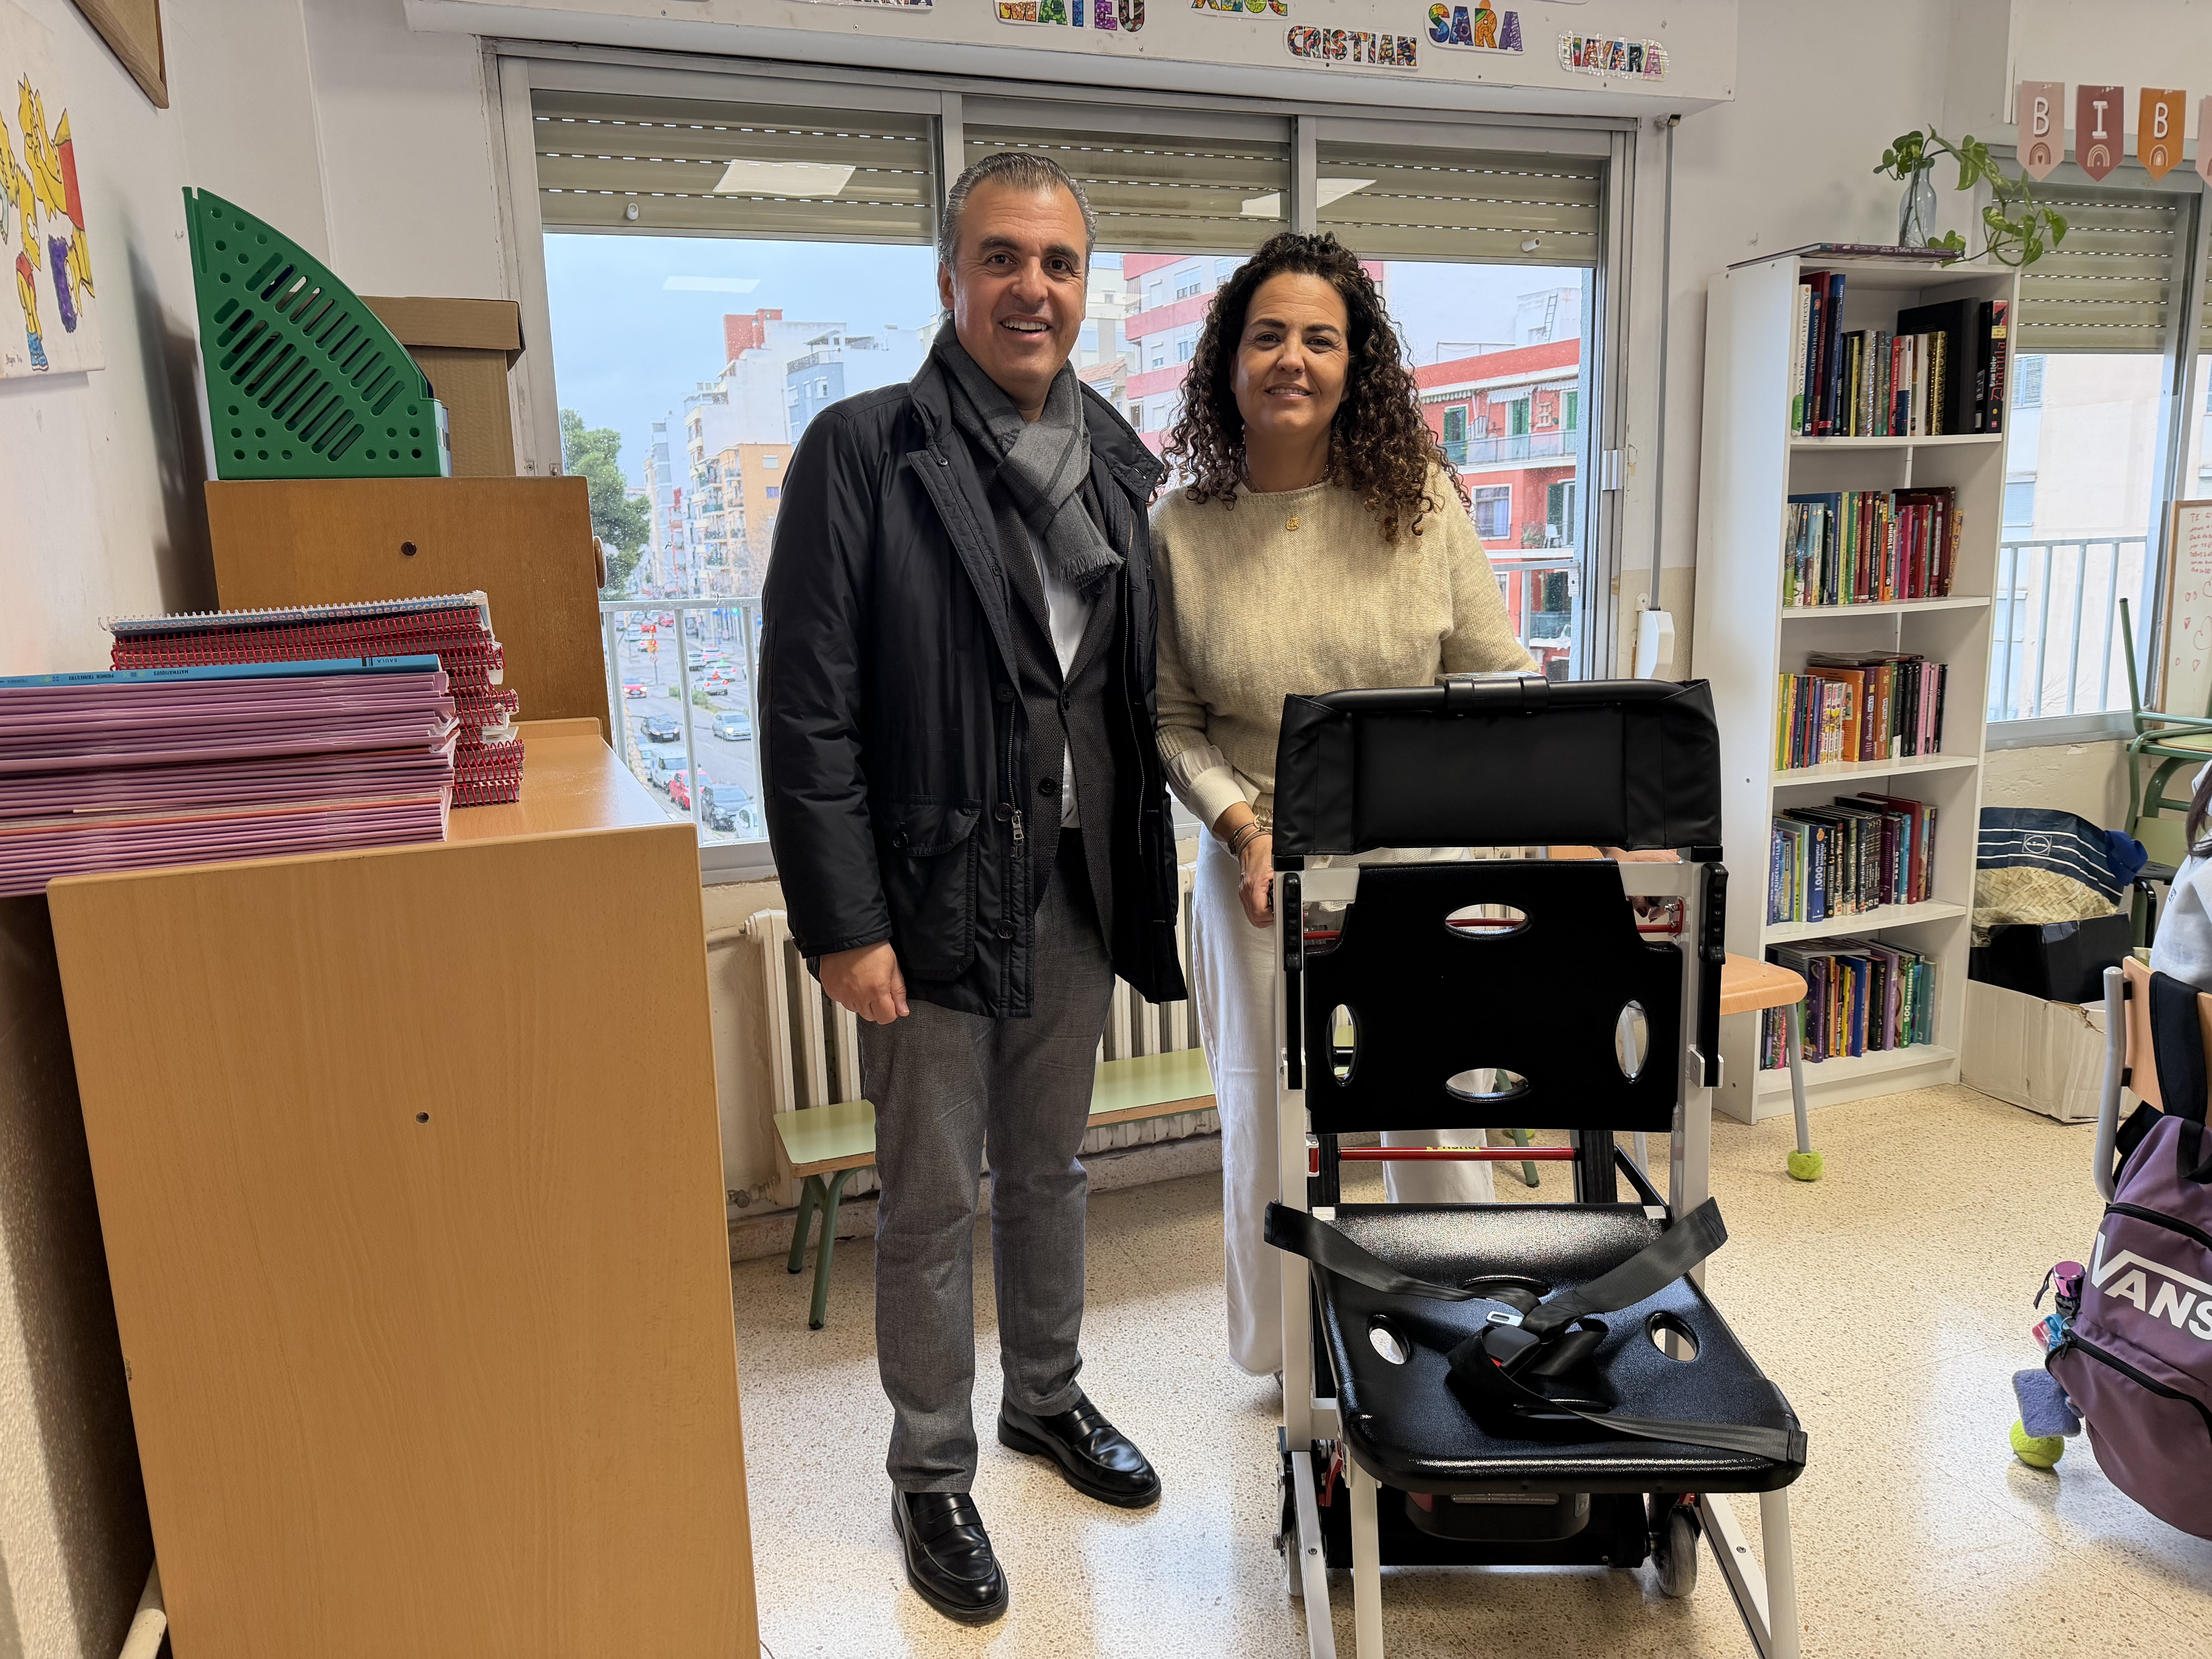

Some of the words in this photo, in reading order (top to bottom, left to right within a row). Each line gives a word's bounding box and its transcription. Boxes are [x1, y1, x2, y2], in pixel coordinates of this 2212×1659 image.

[1429, 3, 1523, 52] SARA
[1289, 26, 1417, 66] CRISTIAN
[1812, 315, 1820, 344] HUMANO
[1810, 345, 1818, 371] CUERPO
[1813, 866, 1824, 891] 1.000
[1905, 968, 1915, 1005] DINOSAURIOS
[1903, 1005, 1911, 1022] 500
[2092, 1231, 2212, 1340] VANS
